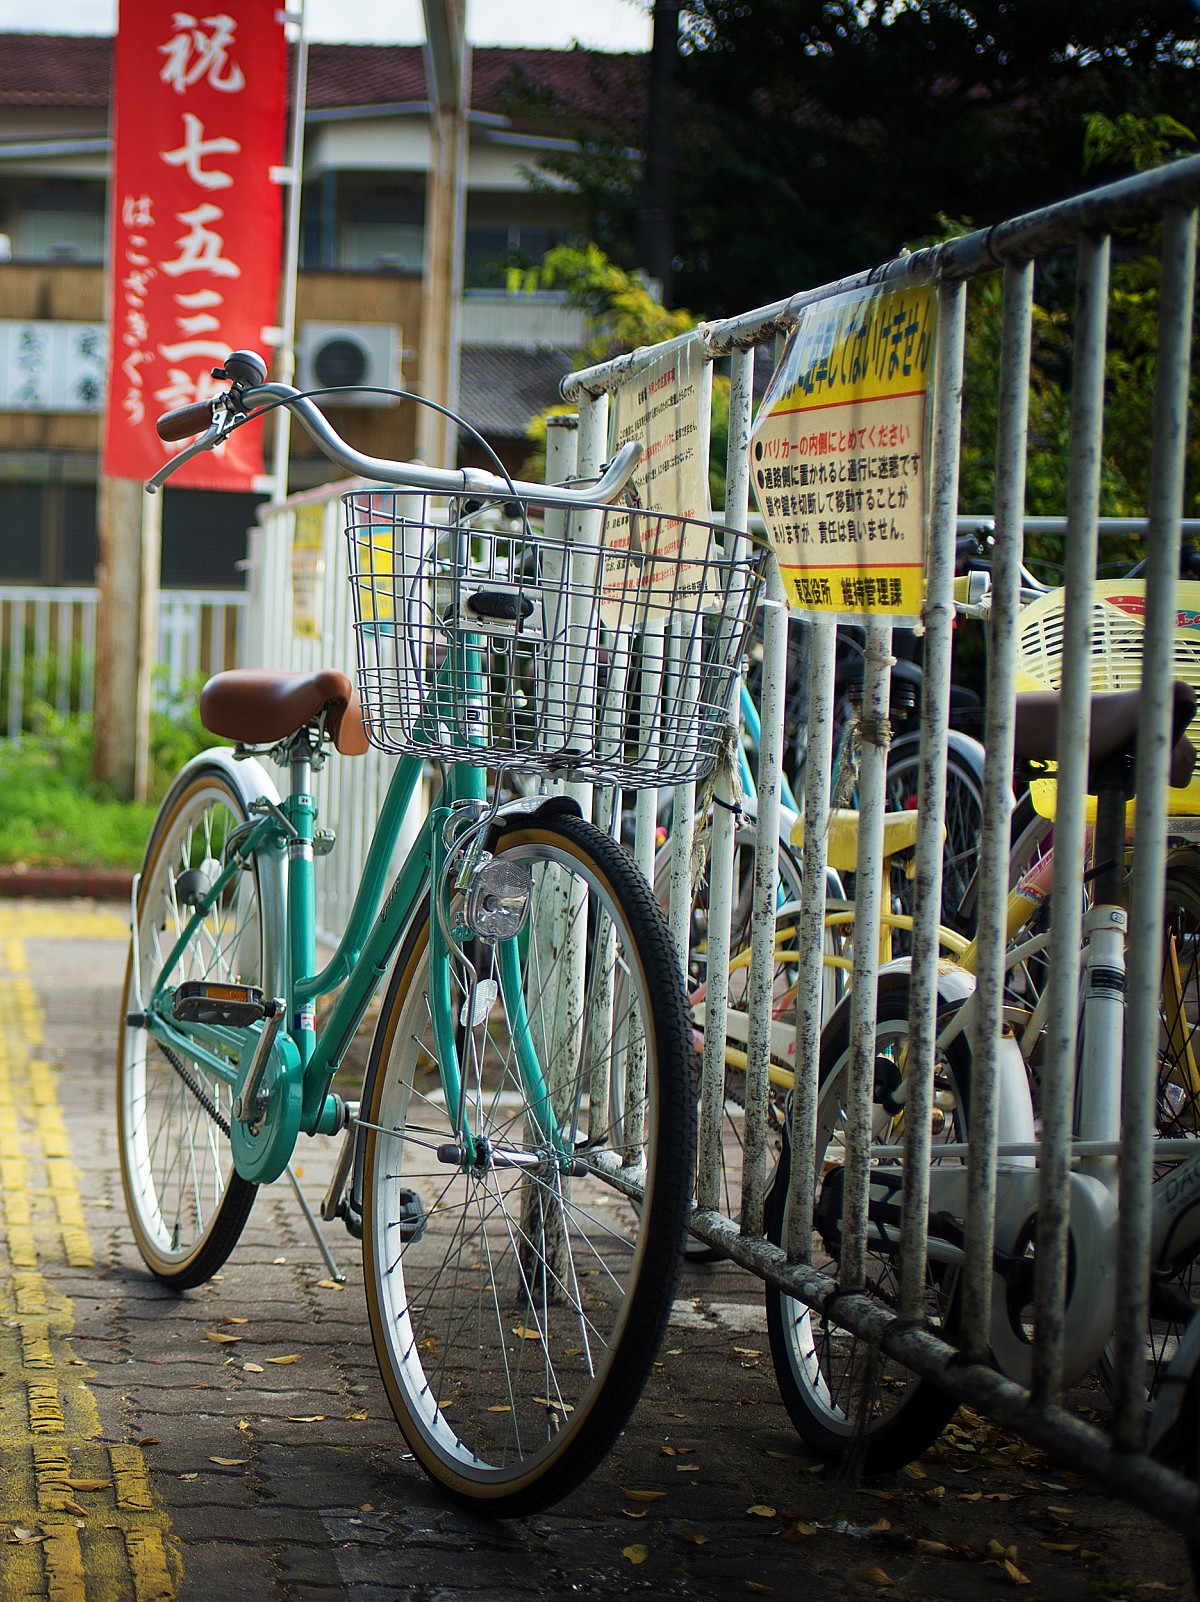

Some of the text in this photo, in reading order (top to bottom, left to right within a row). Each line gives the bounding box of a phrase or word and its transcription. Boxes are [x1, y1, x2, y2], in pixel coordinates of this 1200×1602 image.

[763, 424, 910, 459] バリカーの内側にとめてください
[764, 452, 920, 489] 通路側に置かれると通行に迷惑です
[772, 517, 904, 544] ありますが、責任は負いません。
[793, 576, 902, 607] 東区役所 維持管理課
